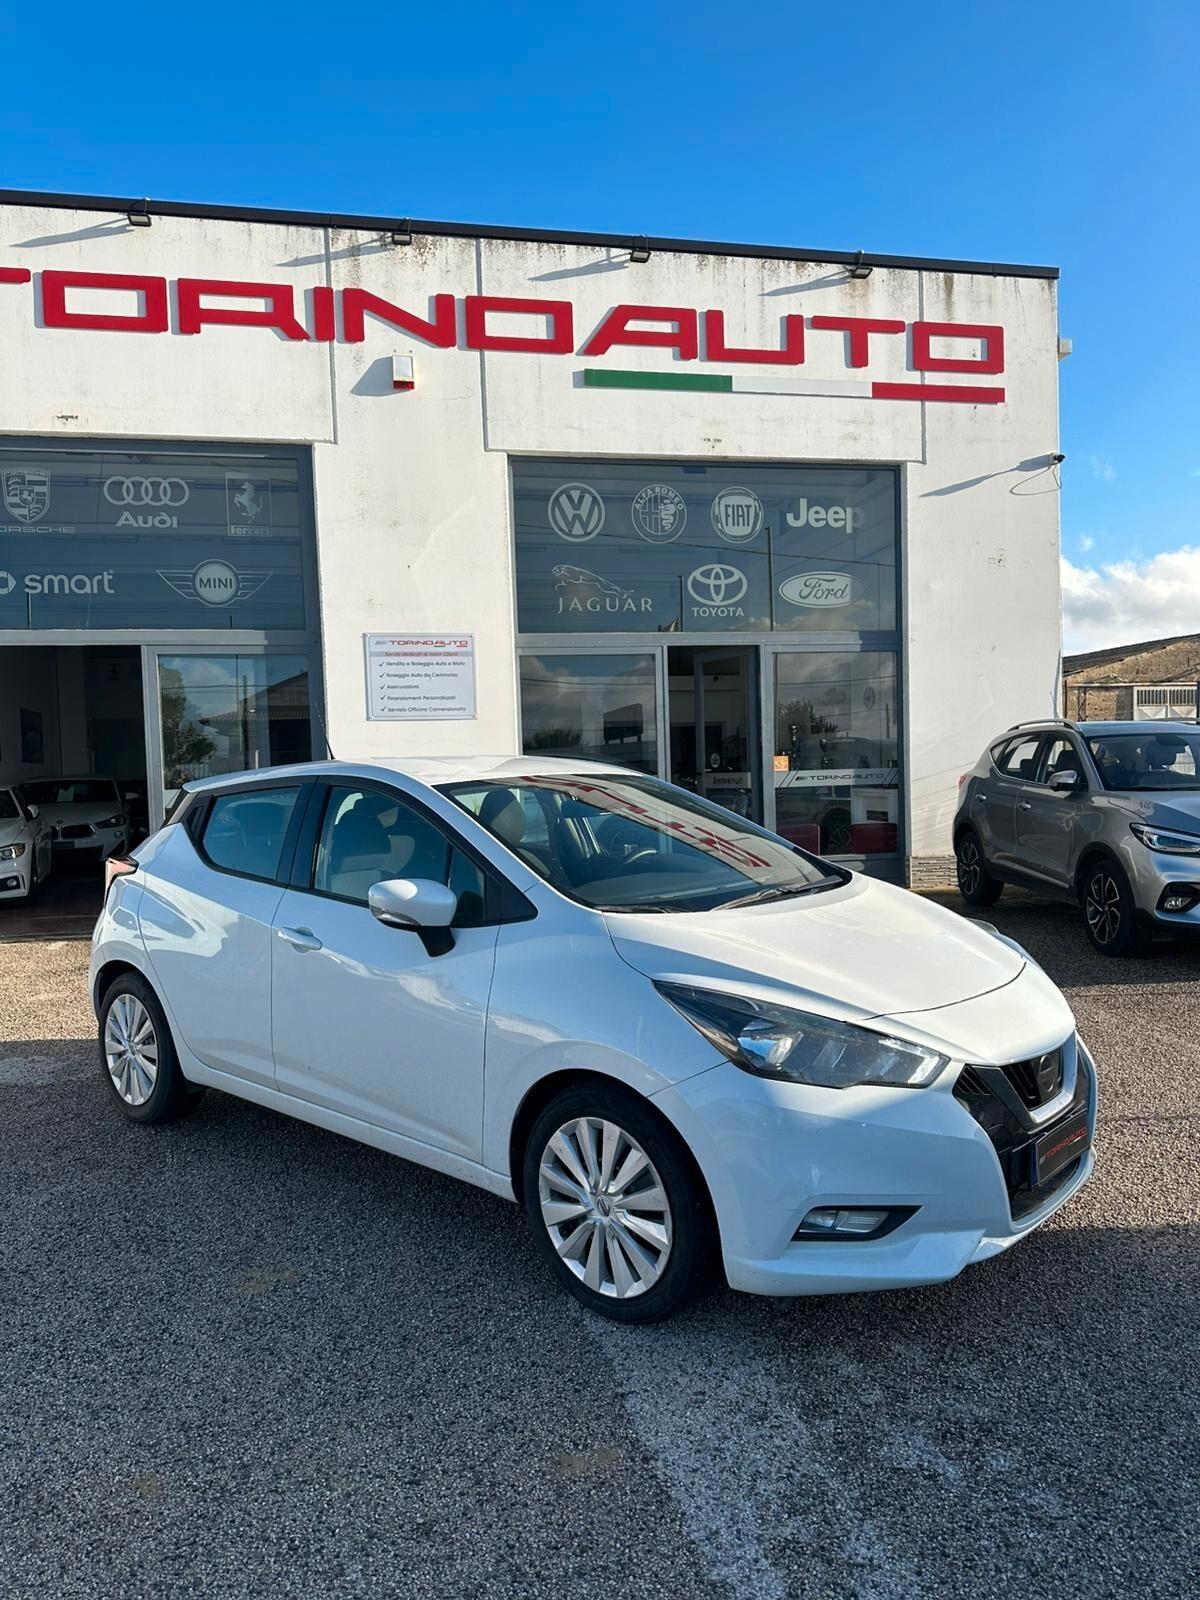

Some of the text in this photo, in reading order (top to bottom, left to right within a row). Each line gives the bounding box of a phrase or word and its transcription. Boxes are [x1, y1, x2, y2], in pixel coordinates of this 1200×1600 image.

[634, 486, 684, 511] ALFA ROMEO
[115, 511, 179, 528] Audi
[724, 504, 753, 527] FIAT
[786, 498, 865, 534] Jeep
[24, 570, 115, 594] smart
[199, 577, 233, 589] MINI
[799, 576, 849, 600] Ford
[557, 597, 653, 614] JAGUAR
[692, 607, 745, 617] TOYOTA
